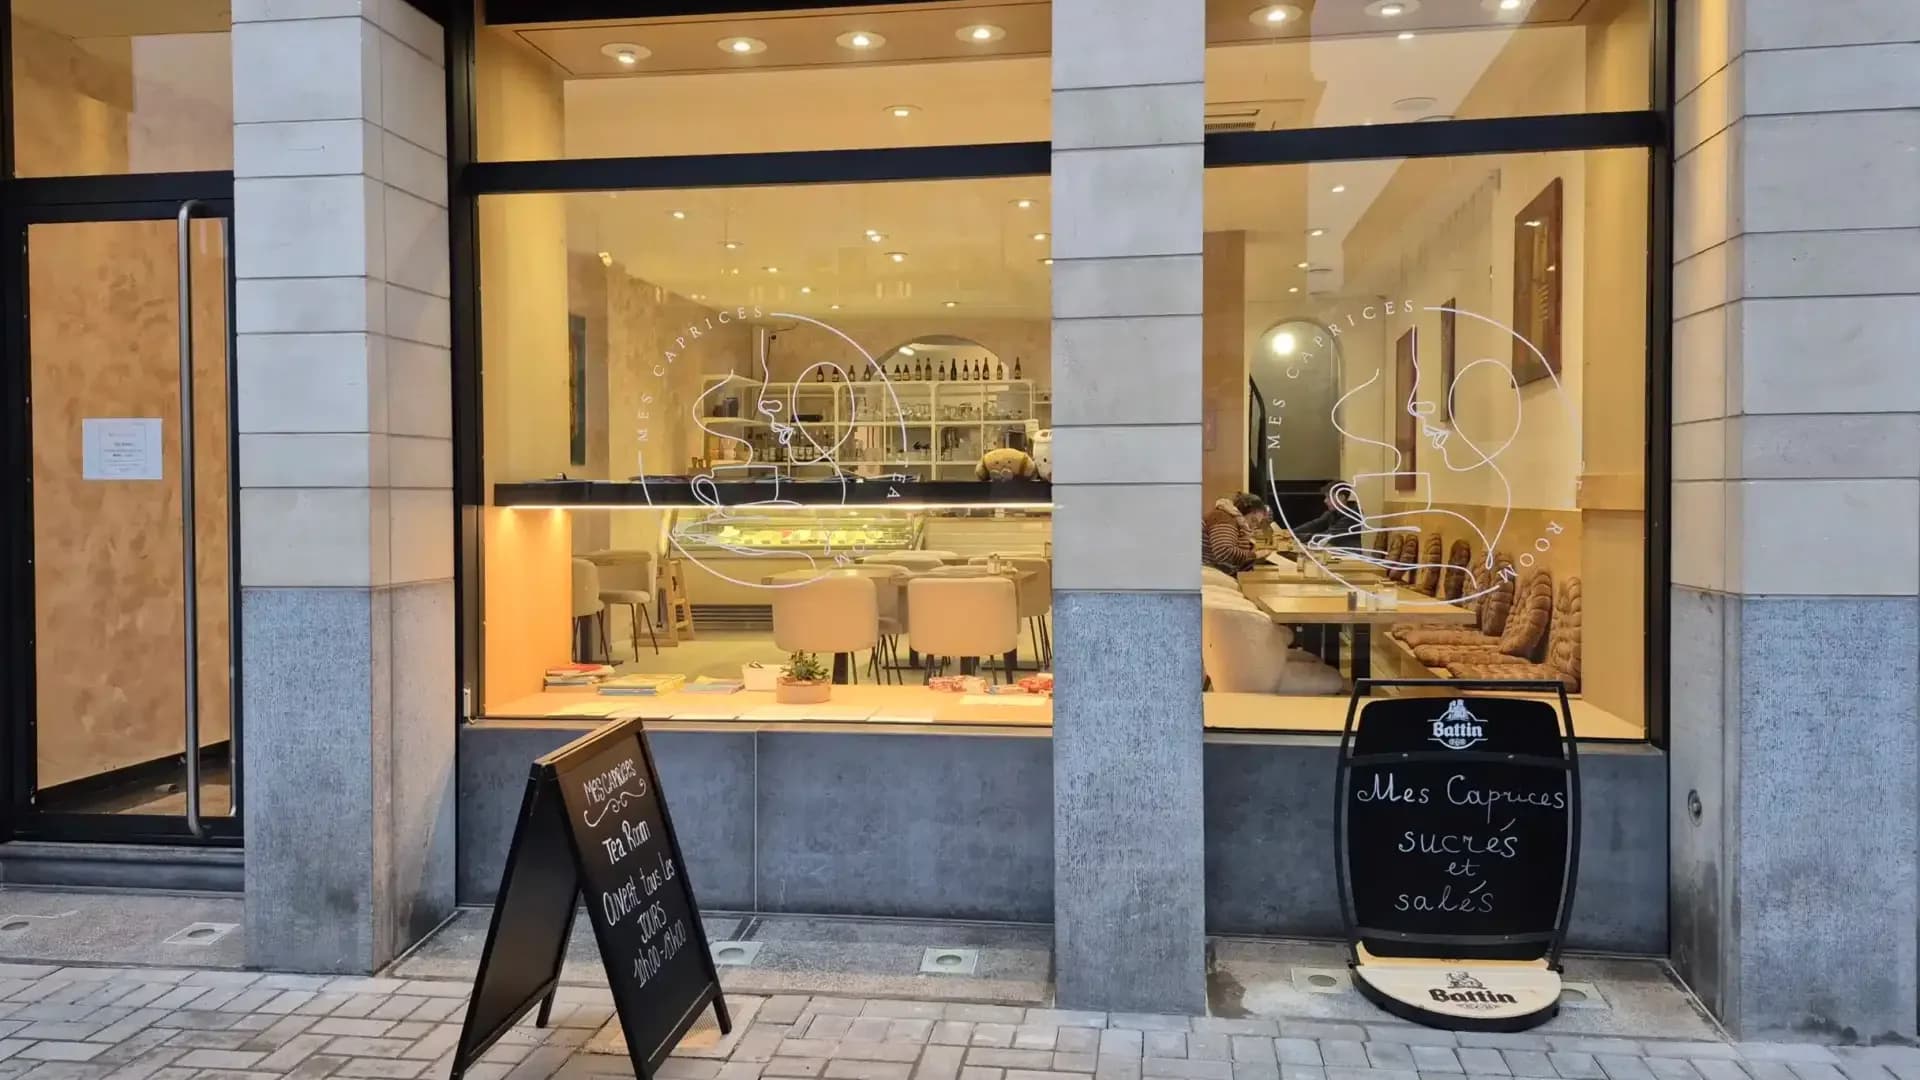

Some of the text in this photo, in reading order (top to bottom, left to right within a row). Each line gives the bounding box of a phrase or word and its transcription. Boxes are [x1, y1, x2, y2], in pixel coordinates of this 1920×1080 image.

[637, 306, 763, 442] MES CAPRICES
[1268, 300, 1414, 450] MES CAPRICES
[885, 457, 909, 498] TEA
[1497, 519, 1564, 584] ROOM
[1432, 721, 1483, 738] Battin
[1356, 772, 1566, 824] Mes Caprices
[602, 820, 652, 865] Tea Room
[1398, 818, 1518, 858] sucrés
[640, 867, 662, 896] tous
[1443, 858, 1481, 876] et
[1393, 879, 1495, 913] salés
[1428, 988, 1519, 1004] Battin
